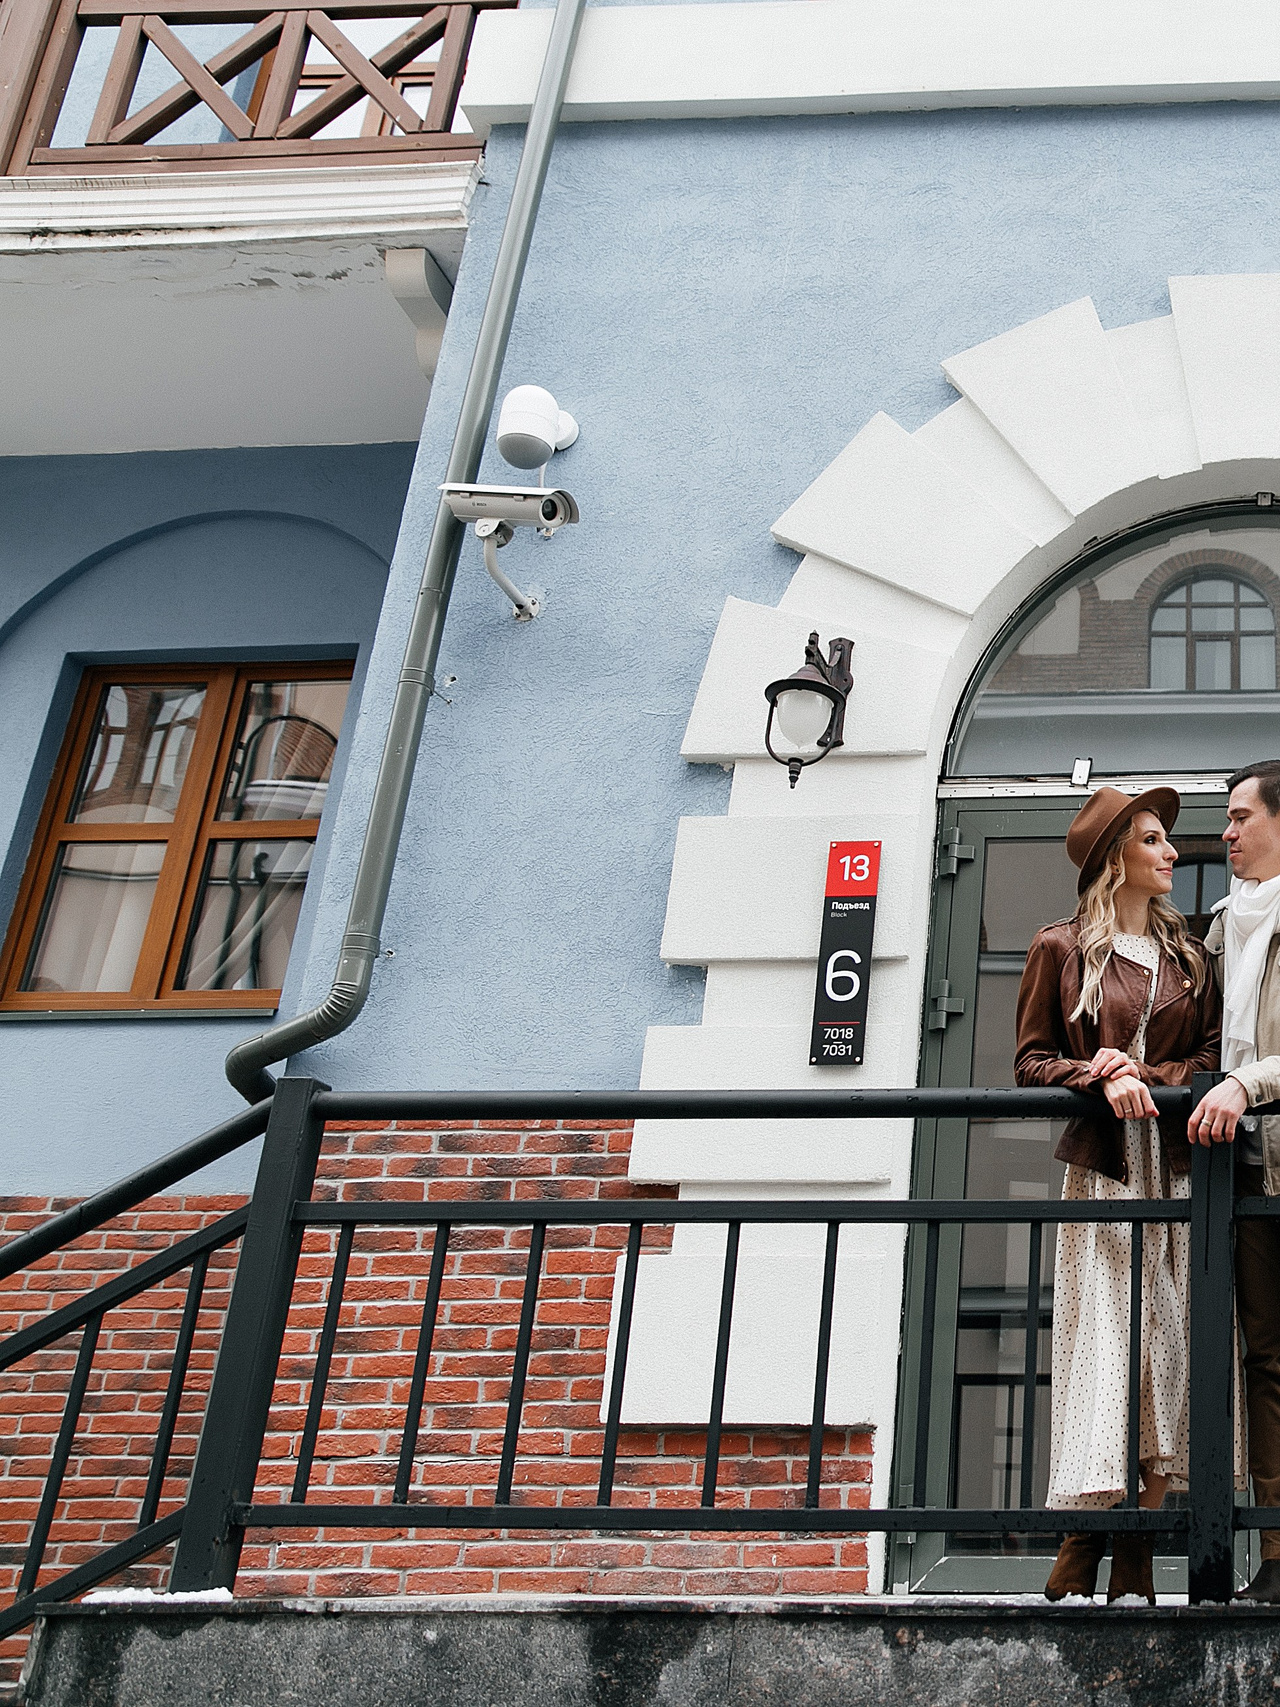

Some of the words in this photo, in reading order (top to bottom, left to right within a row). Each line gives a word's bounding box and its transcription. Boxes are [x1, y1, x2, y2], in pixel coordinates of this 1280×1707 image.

[839, 854, 870, 881] 13
[831, 901, 870, 911] Подъезд
[824, 949, 862, 1002] 6
[823, 1028, 854, 1039] 7018
[822, 1044, 852, 1056] 7031
